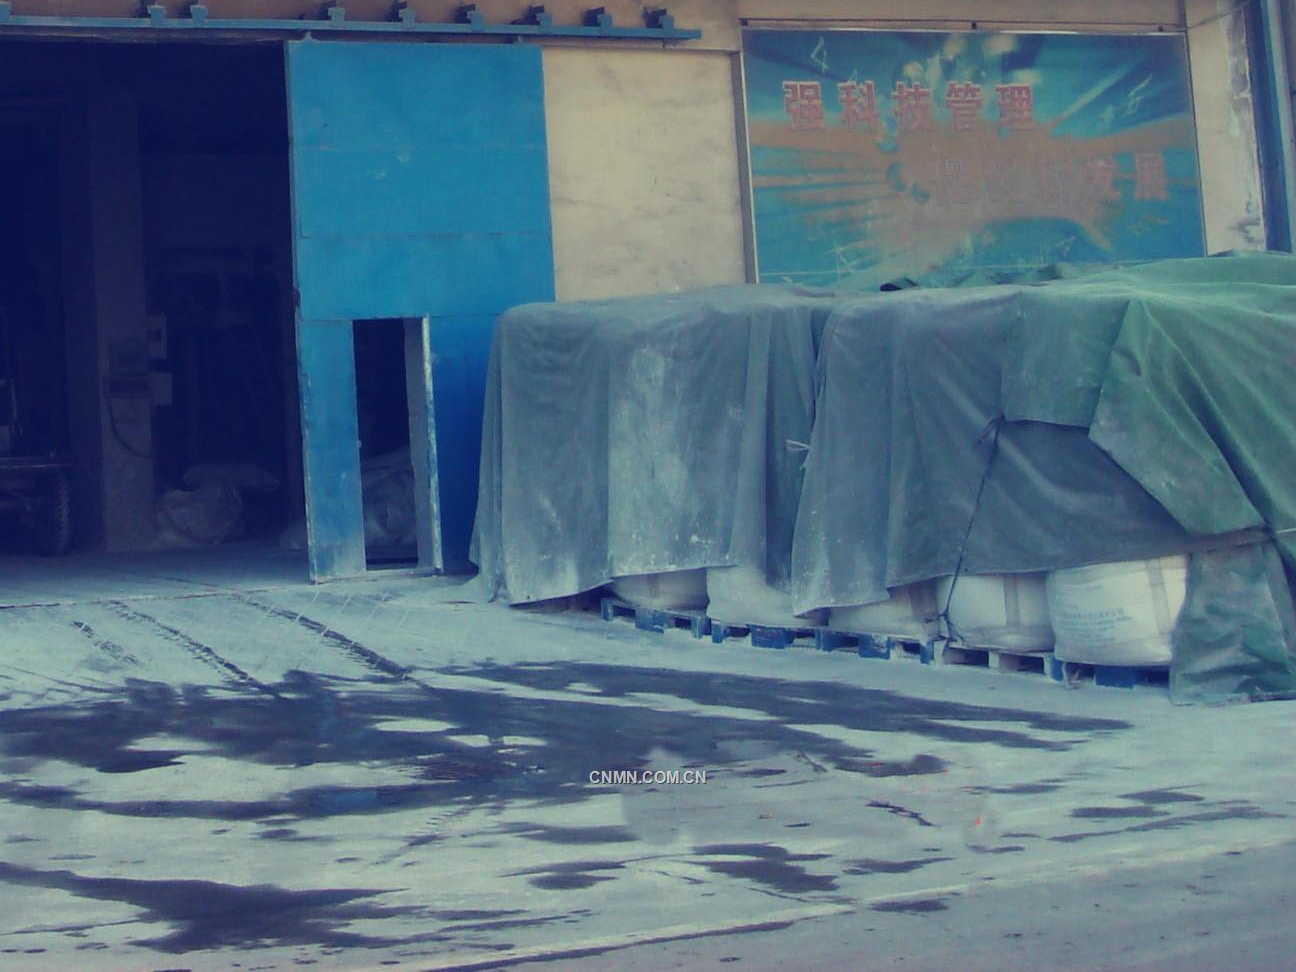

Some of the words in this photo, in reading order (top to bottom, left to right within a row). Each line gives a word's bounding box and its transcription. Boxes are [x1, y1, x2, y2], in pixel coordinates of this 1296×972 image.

[782, 80, 1036, 131] 强科技管理
